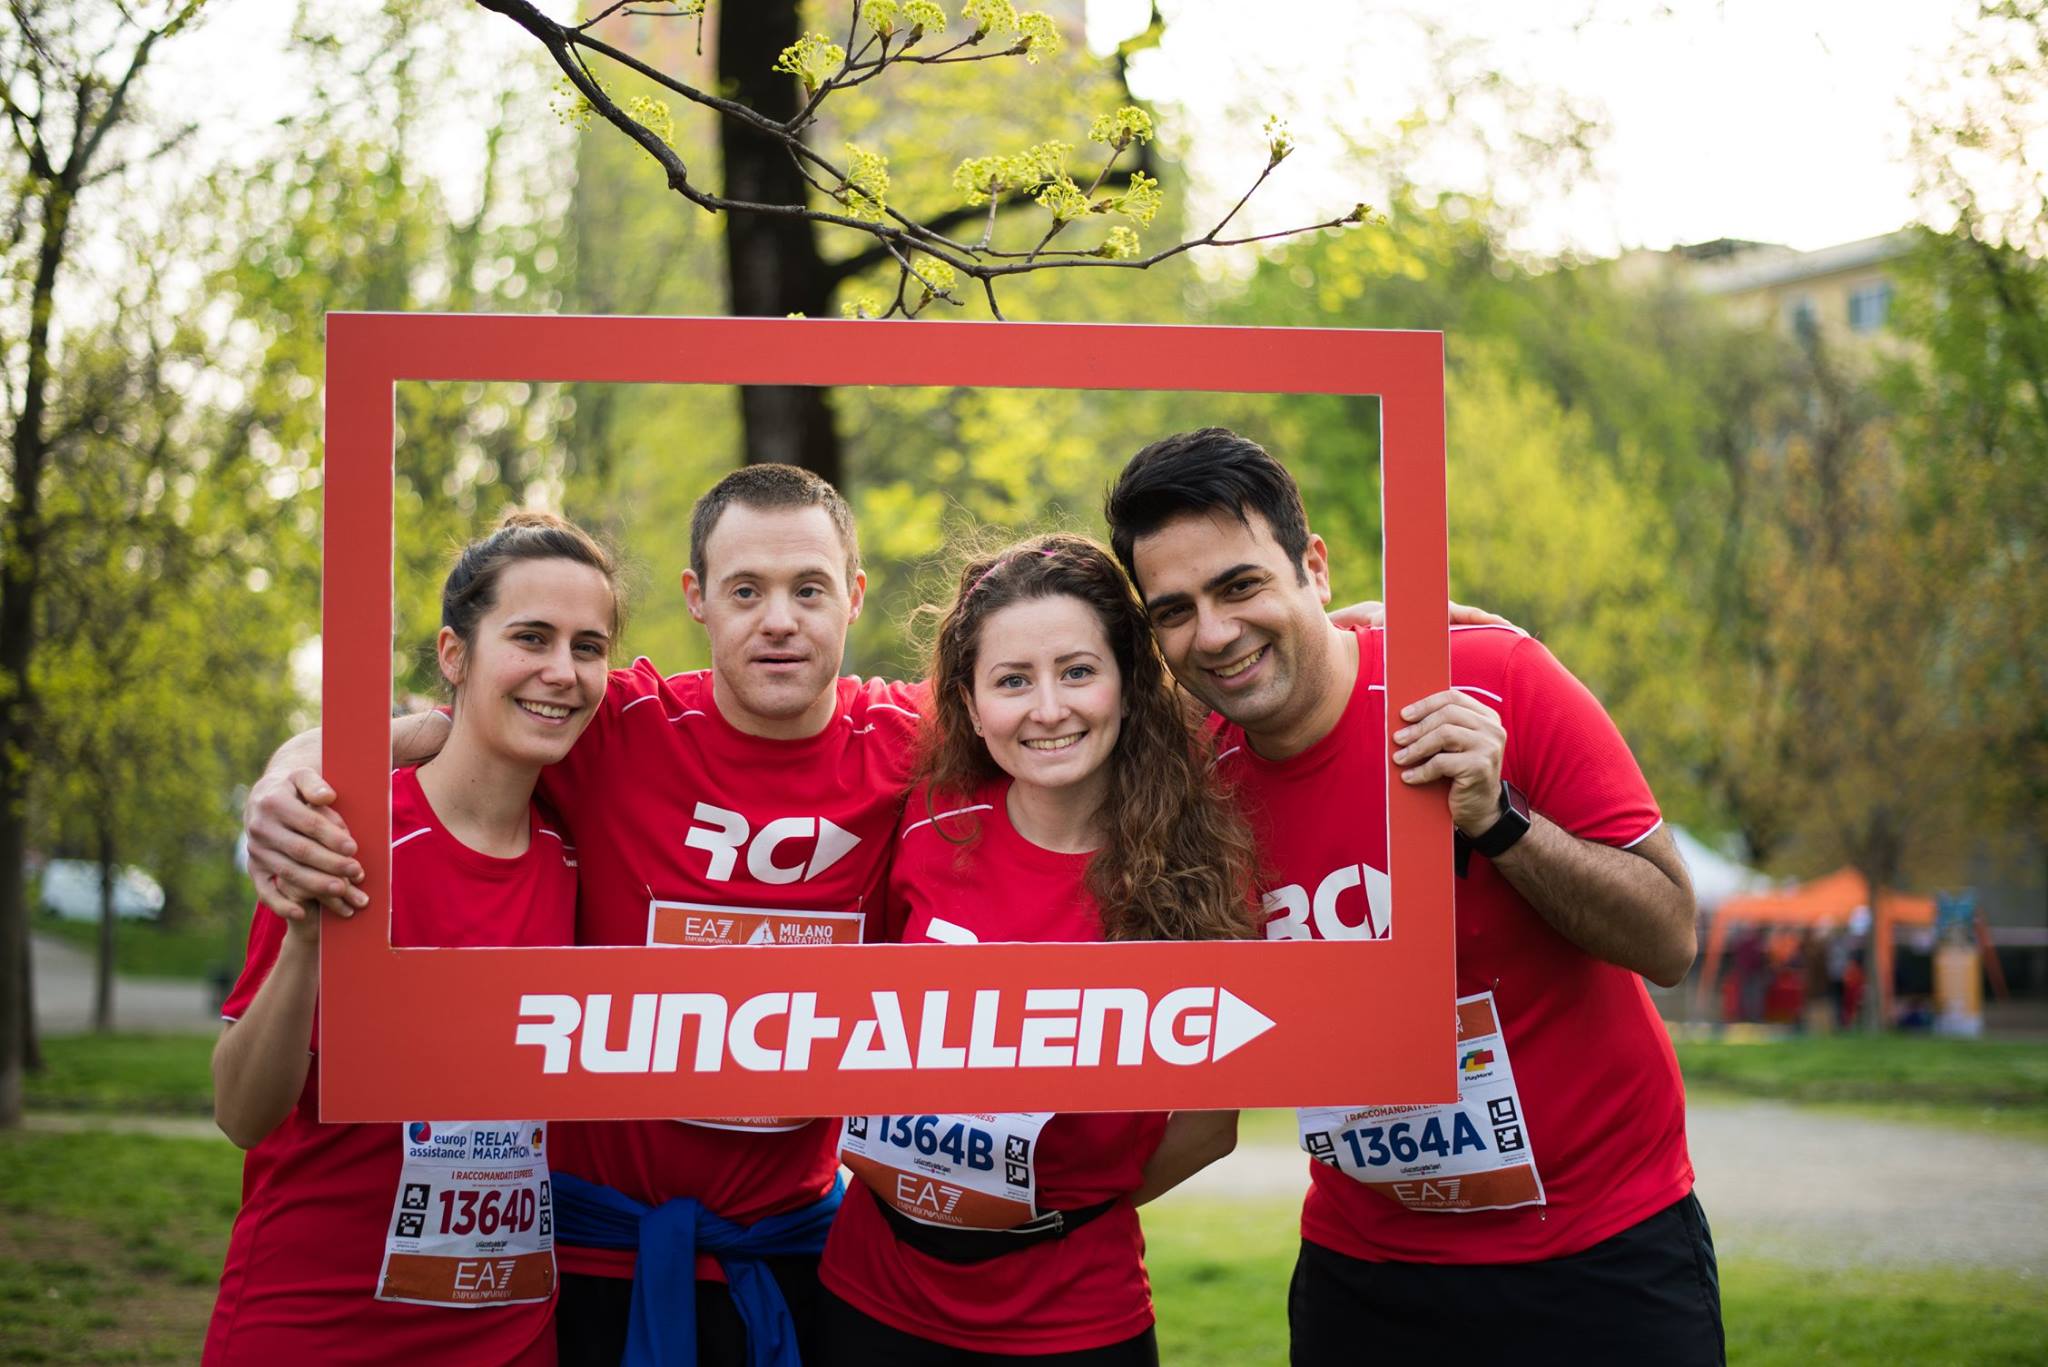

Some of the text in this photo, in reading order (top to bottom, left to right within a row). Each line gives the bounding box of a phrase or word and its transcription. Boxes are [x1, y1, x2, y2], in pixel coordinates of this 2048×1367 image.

[685, 917, 734, 939] EA7
[779, 923, 833, 937] MILANO
[779, 935, 833, 945] MARATHON
[434, 1133, 467, 1148] europ
[474, 1131, 519, 1146] RELAY
[880, 1115, 994, 1172] 1364B
[1341, 1111, 1487, 1169] 1364A
[409, 1145, 466, 1159] assistance
[472, 1146, 530, 1160] MARATHON
[452, 1171, 456, 1180] I
[456, 1170, 513, 1180] RACCOMANDATI
[896, 1173, 963, 1214] EA7
[1392, 1178, 1460, 1201] EA7
[440, 1187, 536, 1236] 1364D
[454, 1260, 516, 1291] EA7
